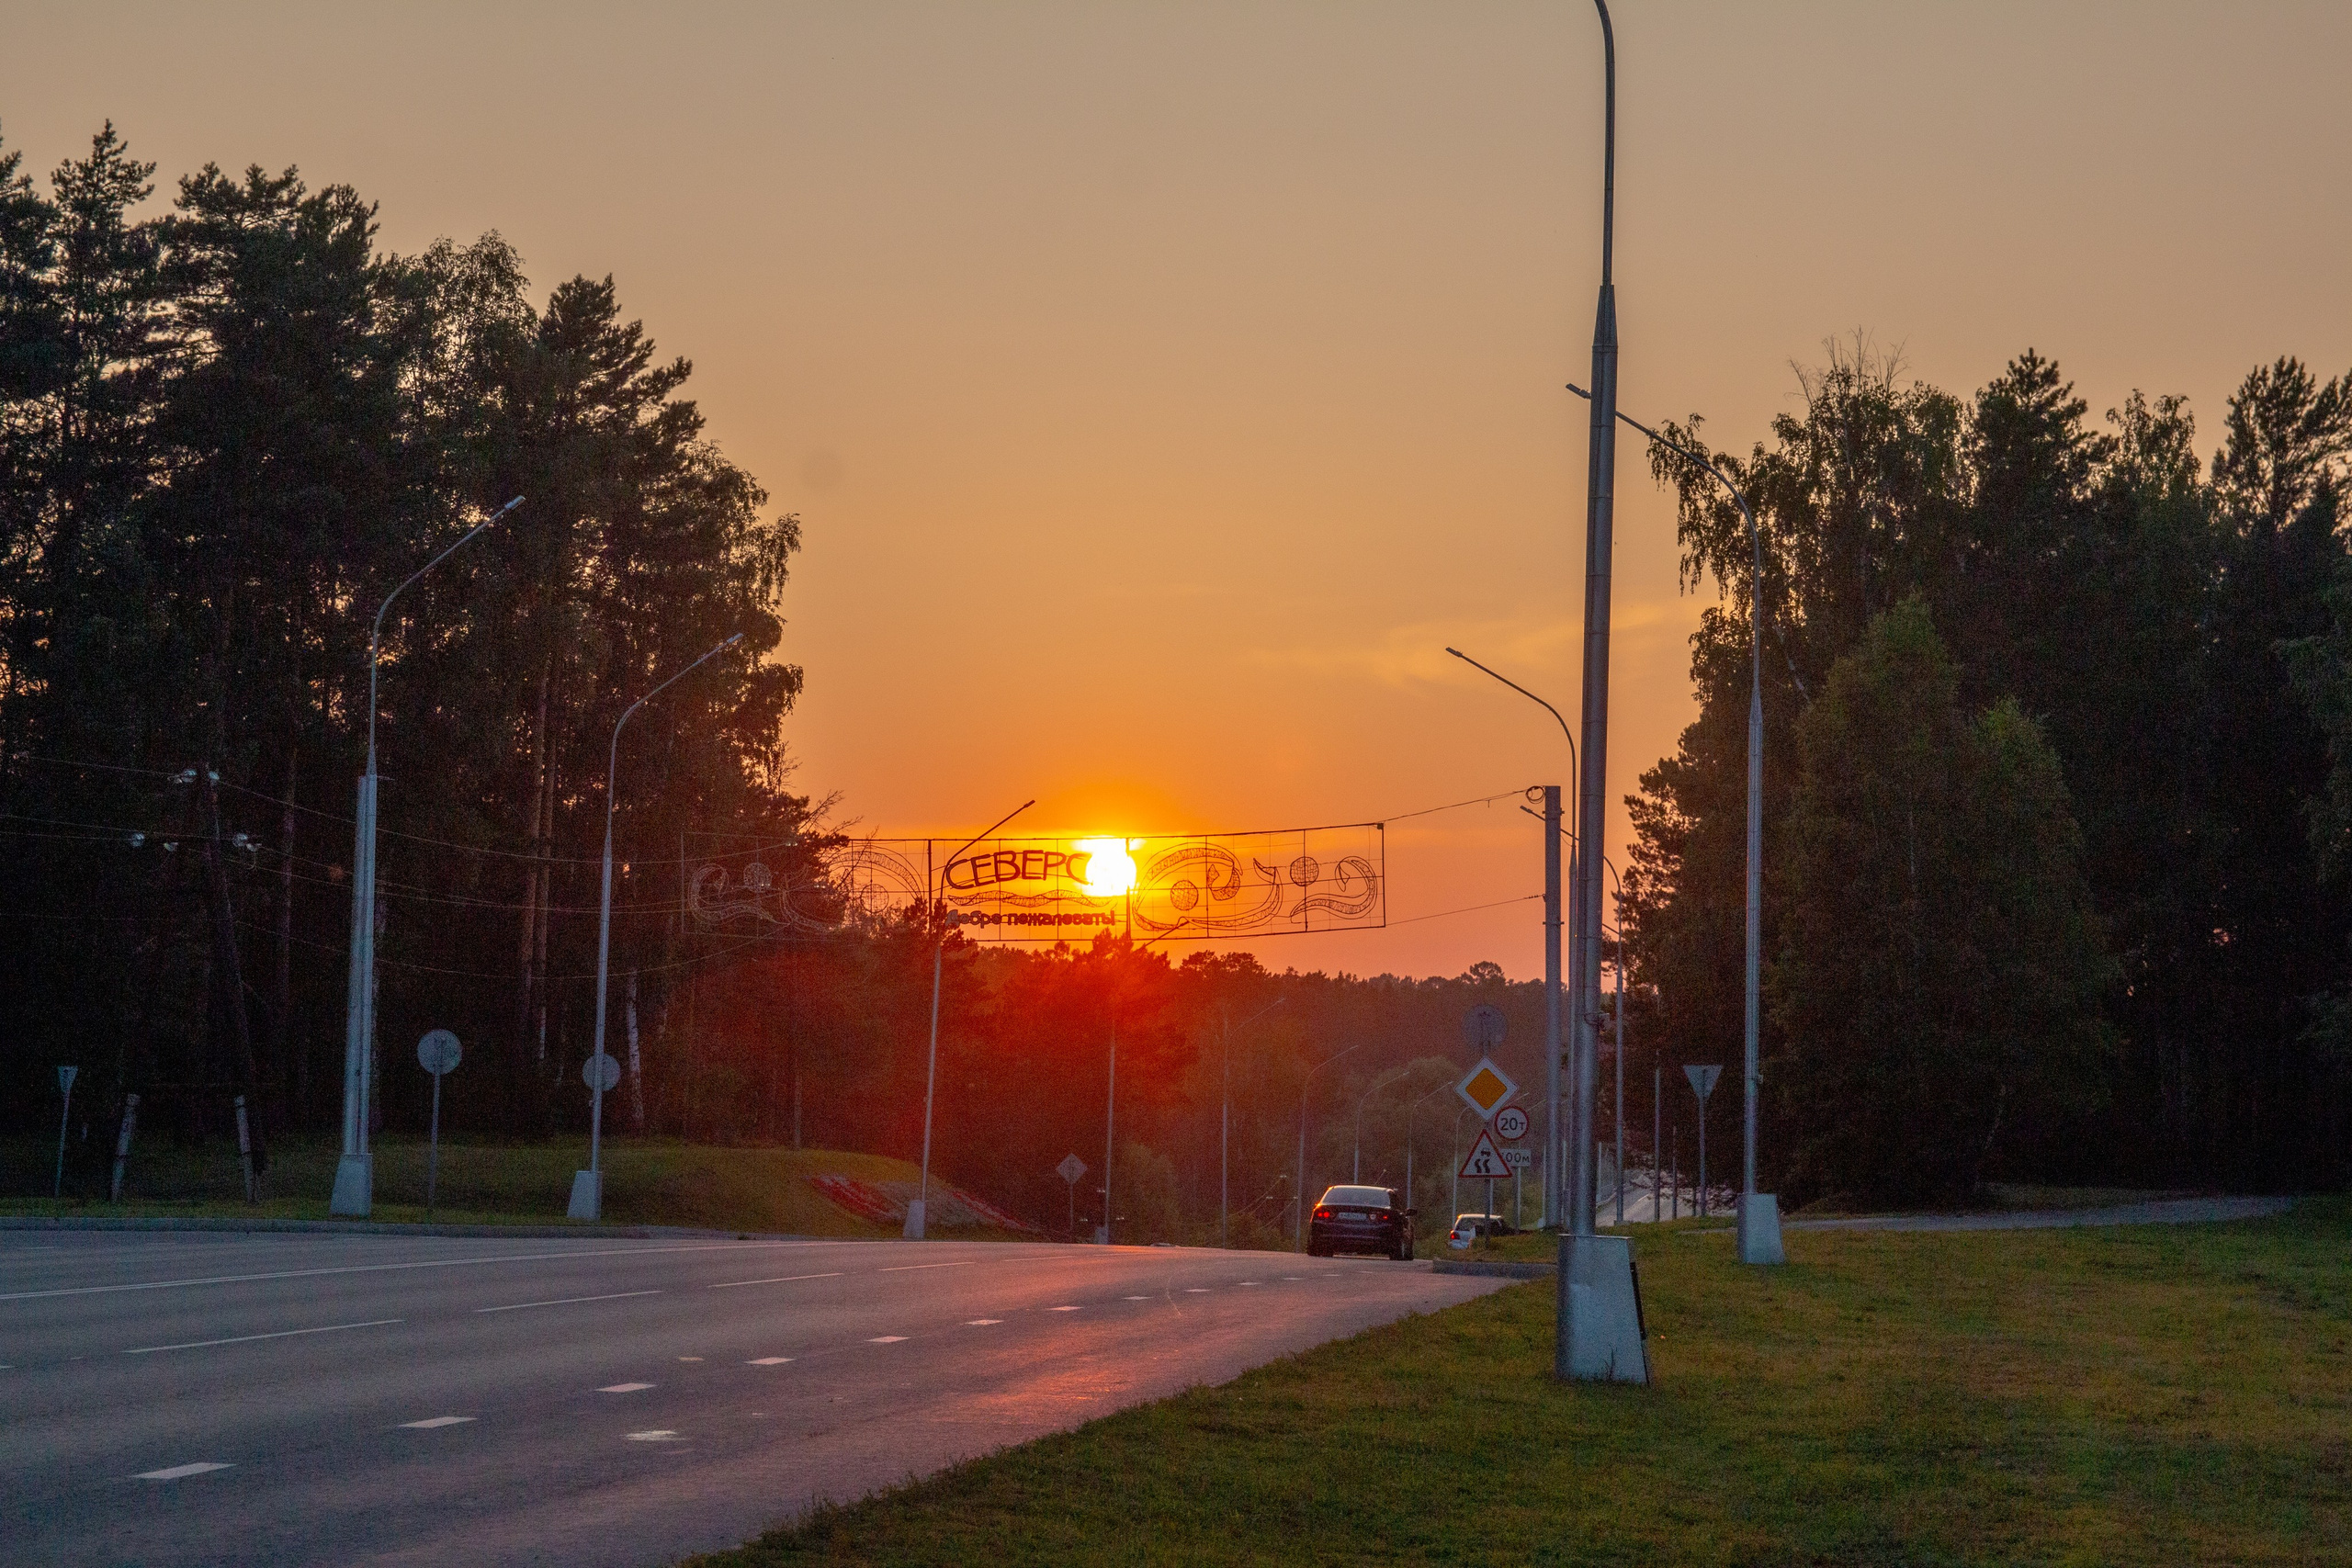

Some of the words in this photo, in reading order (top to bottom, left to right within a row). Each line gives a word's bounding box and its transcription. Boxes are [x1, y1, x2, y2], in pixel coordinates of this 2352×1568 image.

[945, 850, 1095, 889] СЕВЕРС
[944, 909, 1001, 929] Добро
[1501, 1152, 1530, 1163] 00м
